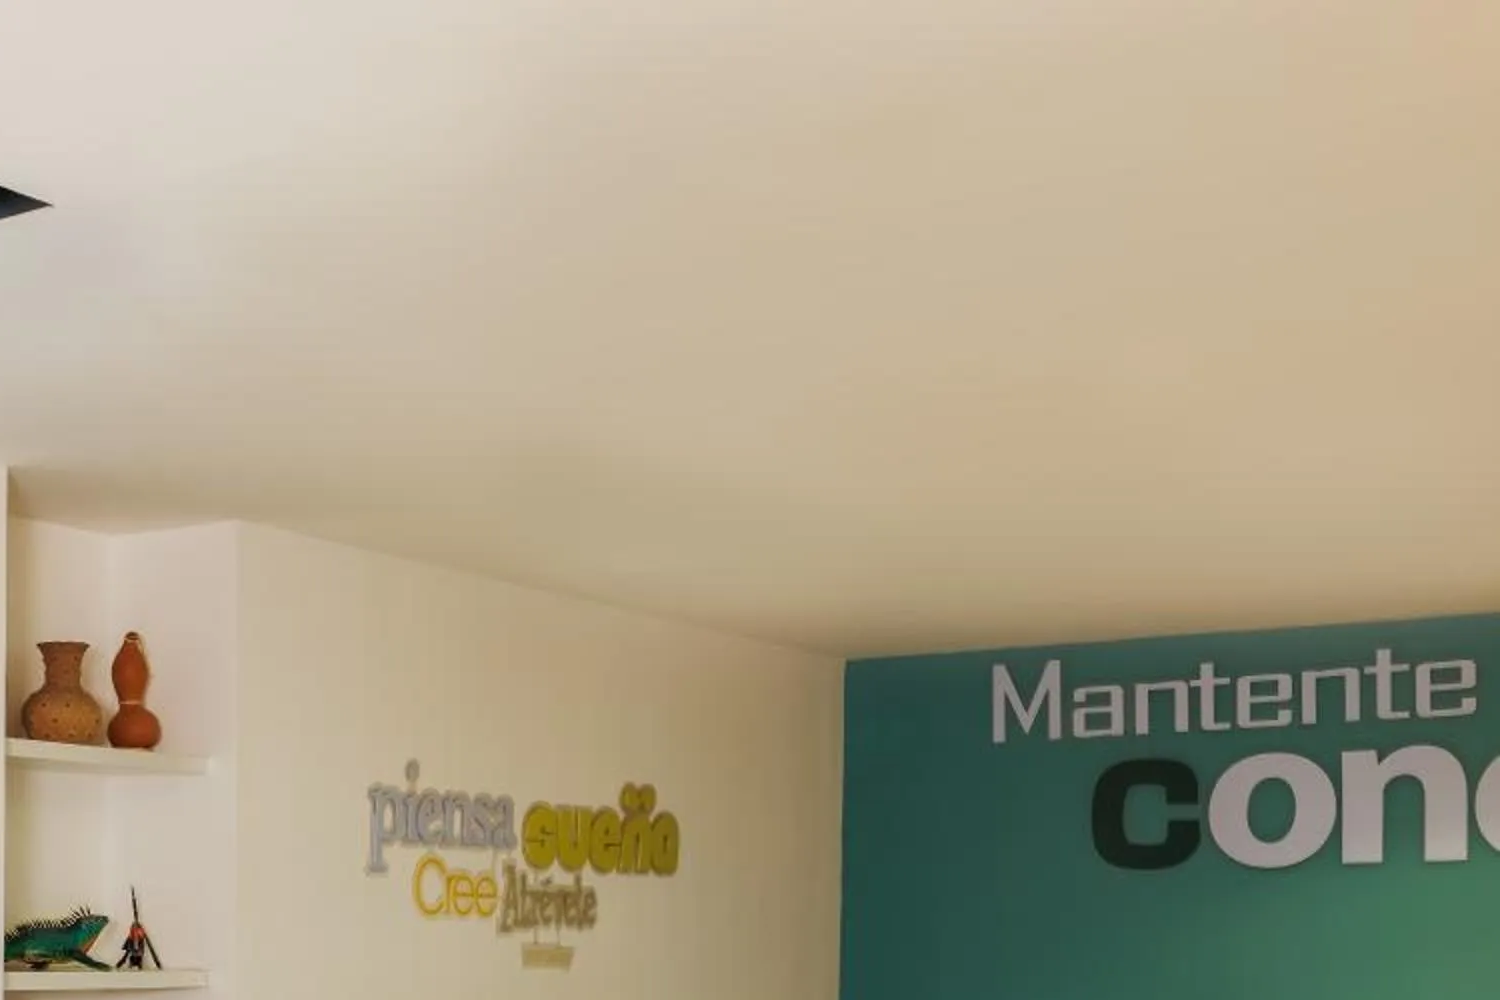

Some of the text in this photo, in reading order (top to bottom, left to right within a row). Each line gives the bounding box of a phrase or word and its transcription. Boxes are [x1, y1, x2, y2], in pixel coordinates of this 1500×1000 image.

[992, 648, 1477, 743] Mantente
[366, 758, 518, 877] piensa
[1091, 744, 1500, 871] con
[412, 853, 498, 918] Cree
